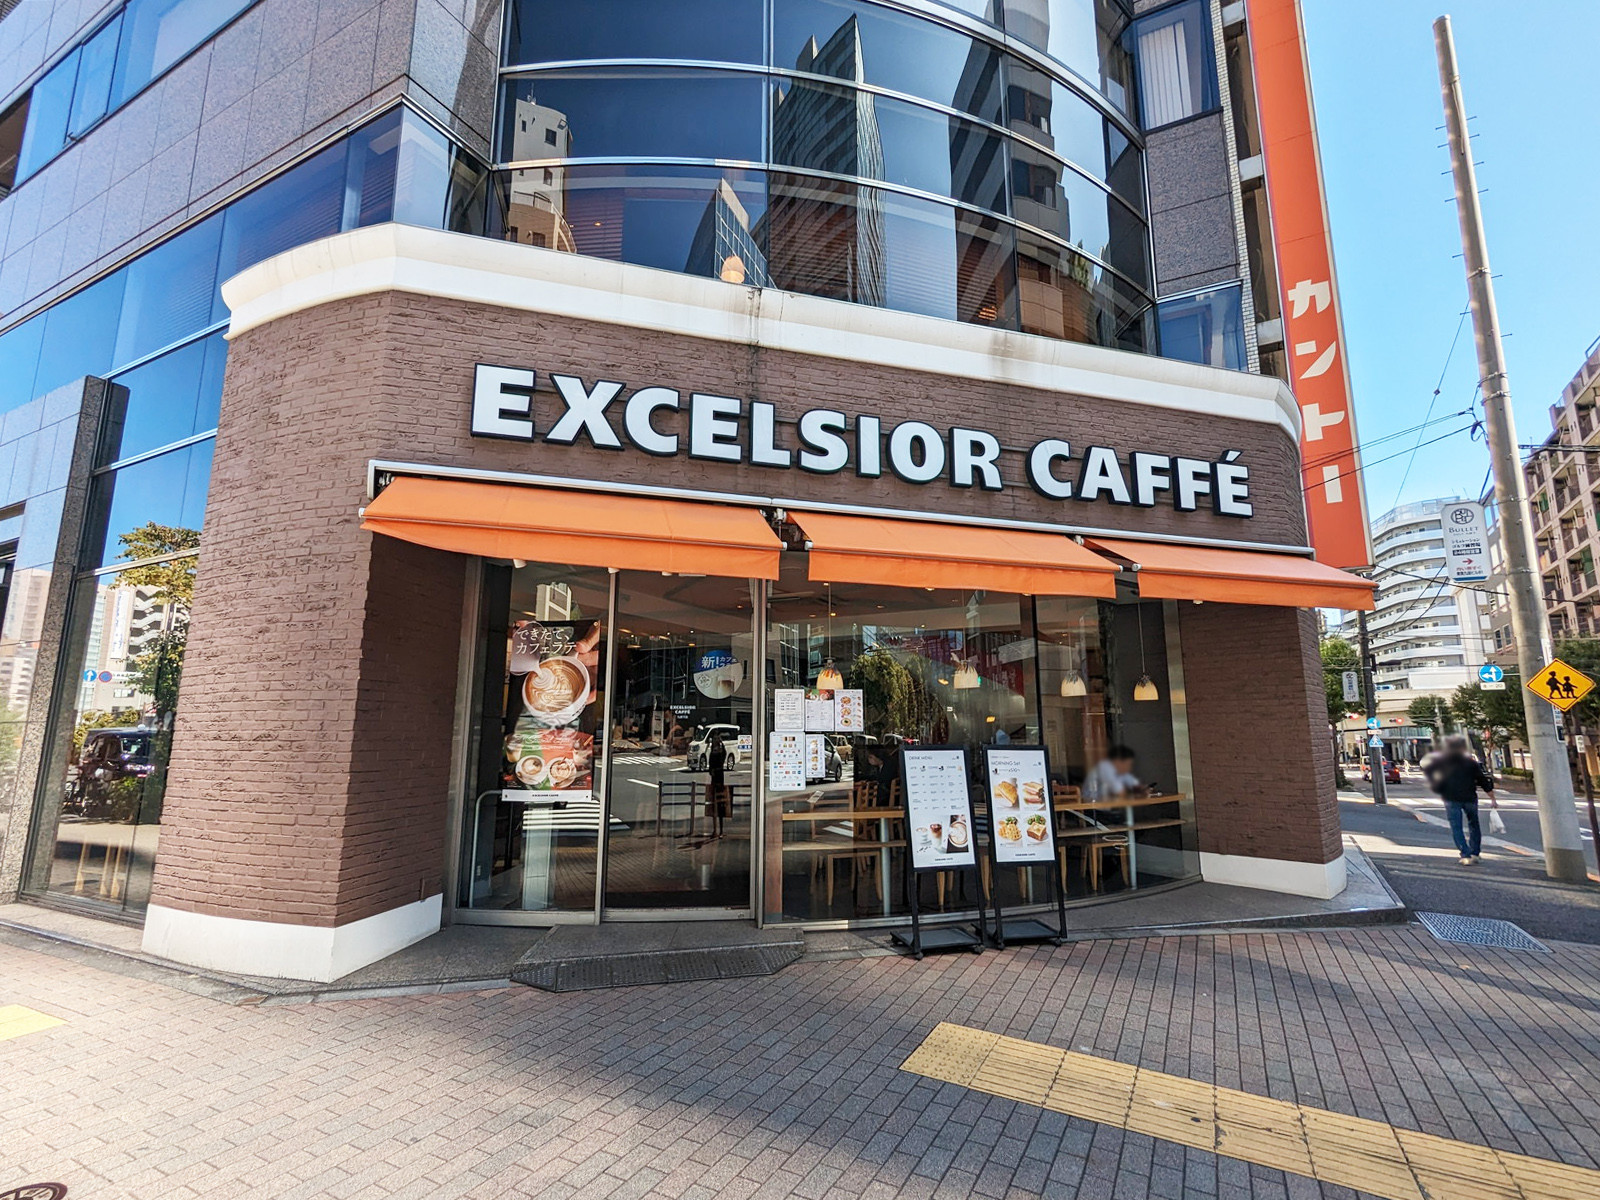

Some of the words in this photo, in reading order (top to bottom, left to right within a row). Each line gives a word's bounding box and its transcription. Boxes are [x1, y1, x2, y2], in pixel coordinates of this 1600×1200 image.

[1287, 278, 1345, 504] カントー
[470, 362, 1004, 491] EXCELSIOR
[1024, 438, 1254, 519] CAFFÉ
[515, 641, 577, 655] カフェラテ
[517, 628, 571, 641] できたて、
